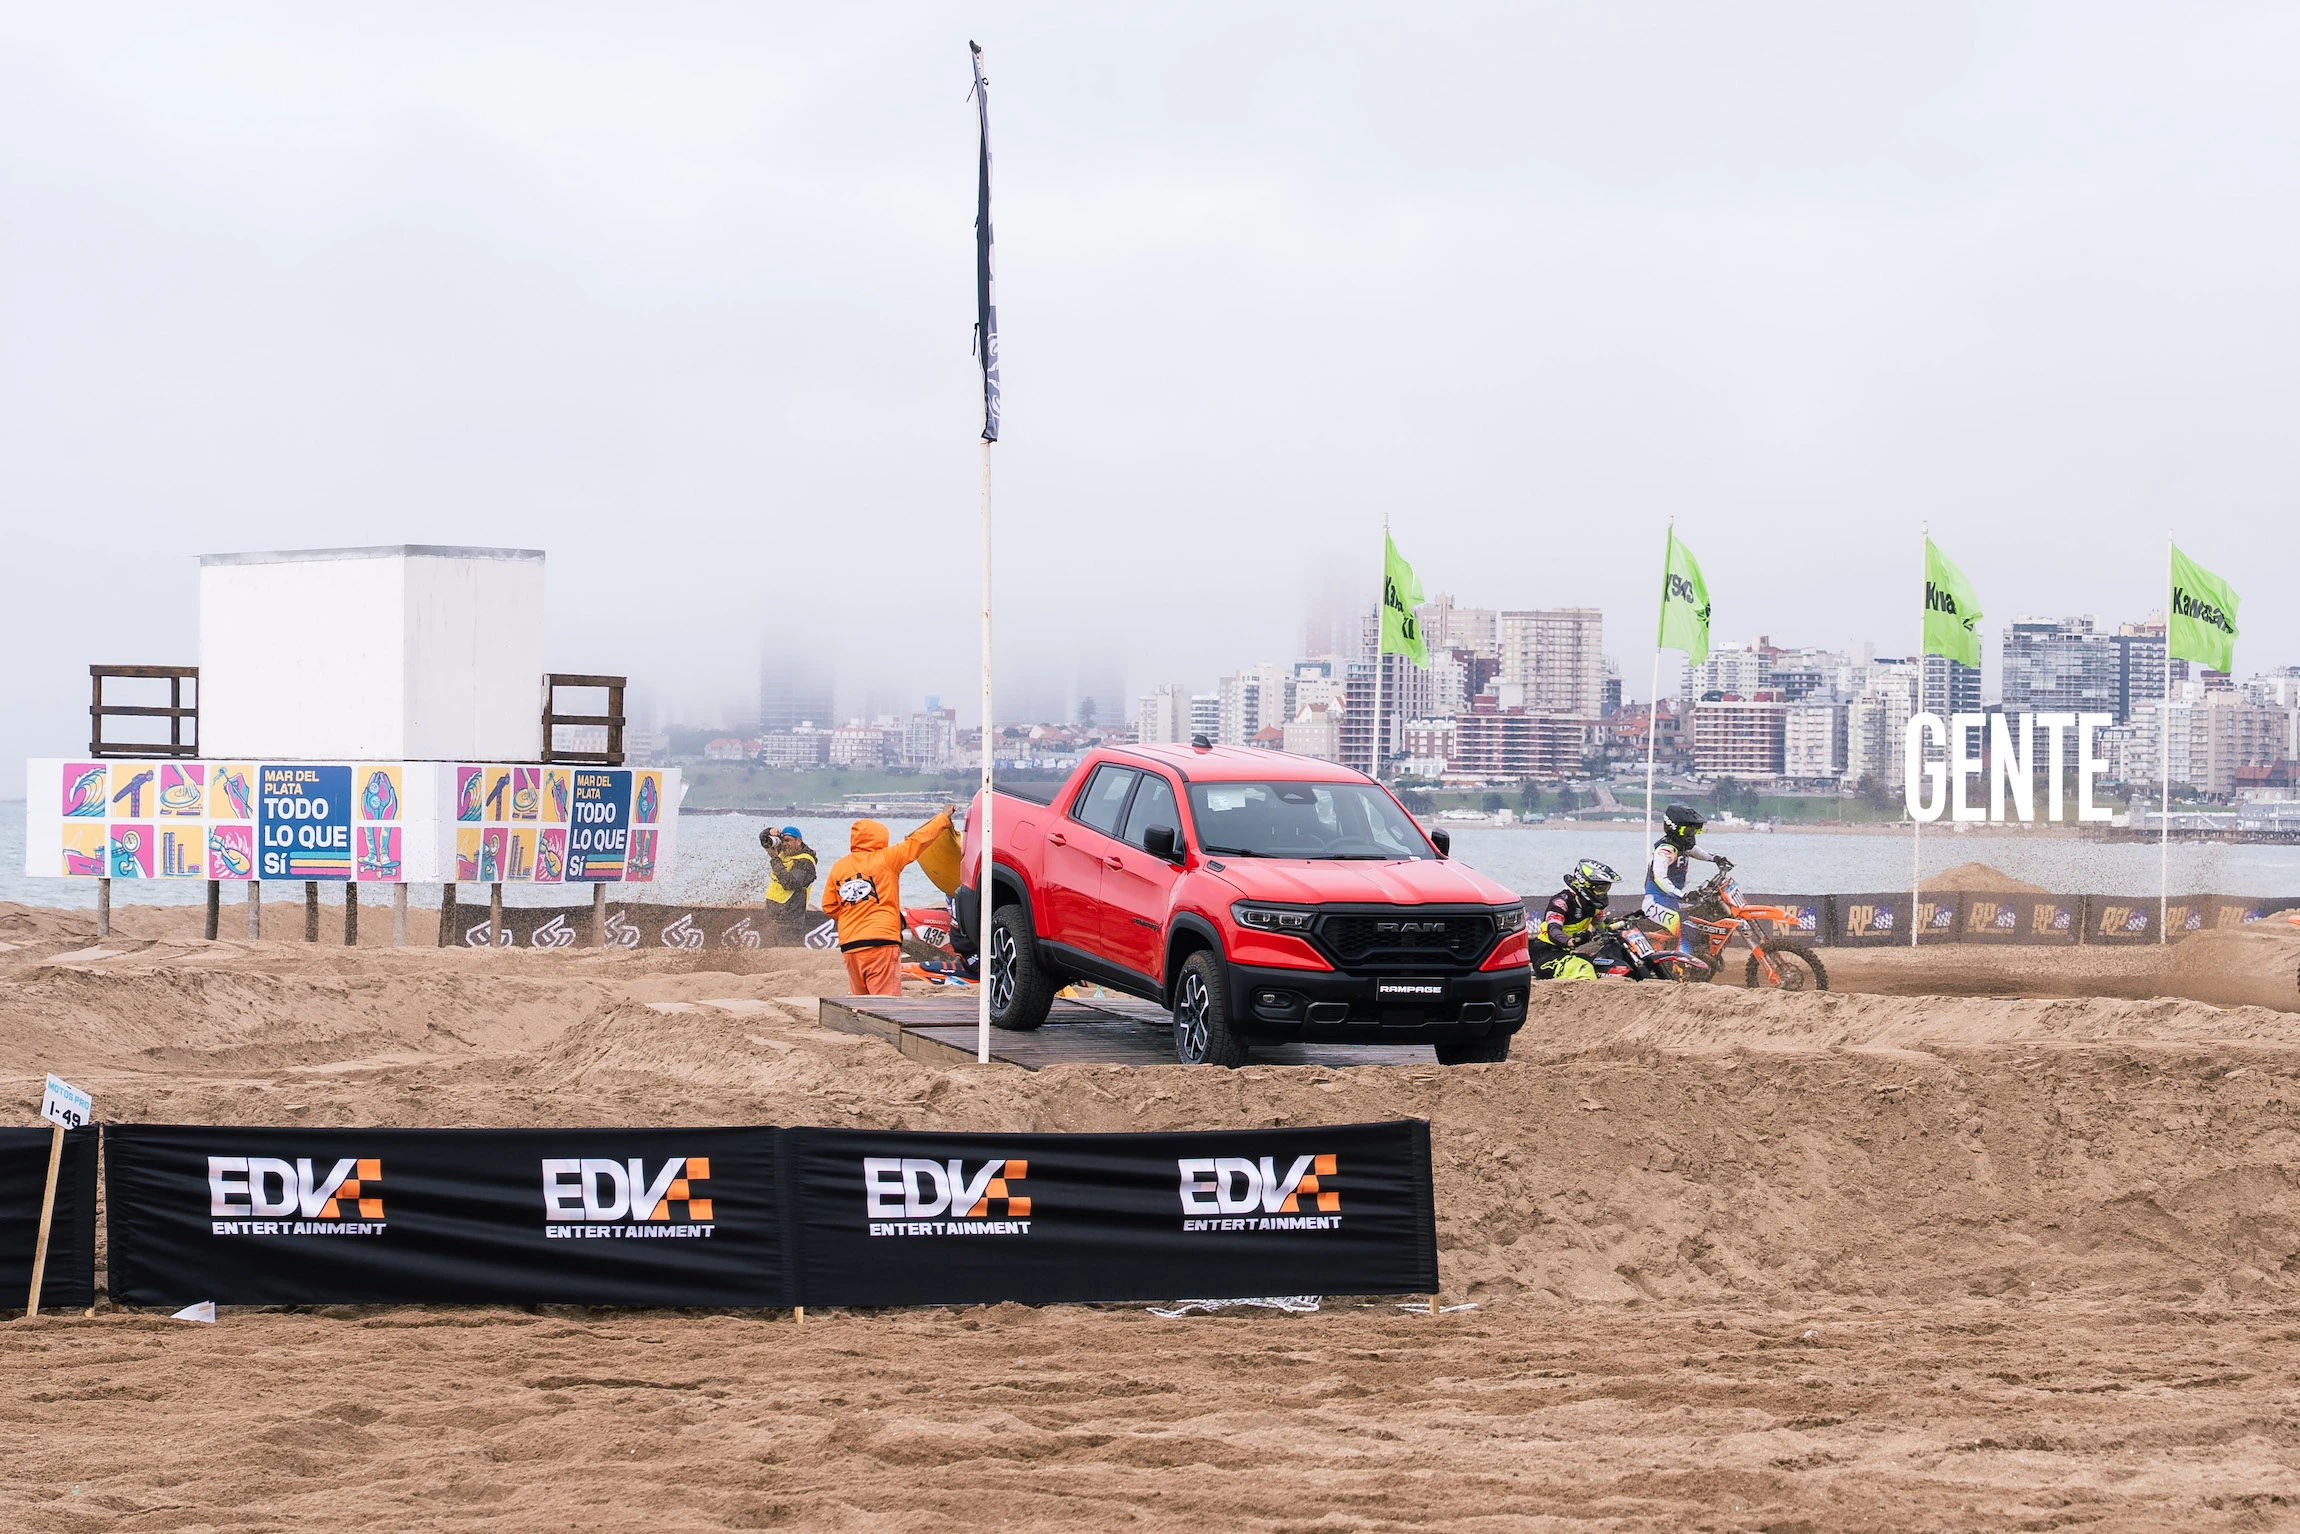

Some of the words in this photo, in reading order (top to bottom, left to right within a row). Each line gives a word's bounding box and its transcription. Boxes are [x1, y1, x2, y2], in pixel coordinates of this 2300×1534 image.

[264, 770, 293, 782] MAR
[295, 770, 320, 782] DEL
[577, 775, 596, 787] MAR
[596, 775, 612, 787] DEL
[264, 783, 303, 795] PLATA
[576, 788, 601, 800] PLATA
[263, 797, 329, 820] TODO
[575, 802, 617, 824] TODO
[264, 825, 294, 848] LO
[298, 825, 348, 850] QUE
[572, 829, 592, 851] LO
[593, 829, 626, 852] QUE
[264, 851, 288, 875] Sí
[1377, 922, 1446, 933] RAM
[923, 927, 947, 947] 435
[1379, 985, 1442, 994] RAMPAGE
[47, 1081, 74, 1101] MOTOS
[74, 1095, 90, 1110] PRO
[211, 1221, 387, 1236] ENTERTAINMENT
[869, 1221, 1031, 1237] ENTERTAINMENT
[1183, 1216, 1342, 1231] ENTERTAINMENT
[545, 1224, 716, 1239] ENTERTAINMENT
